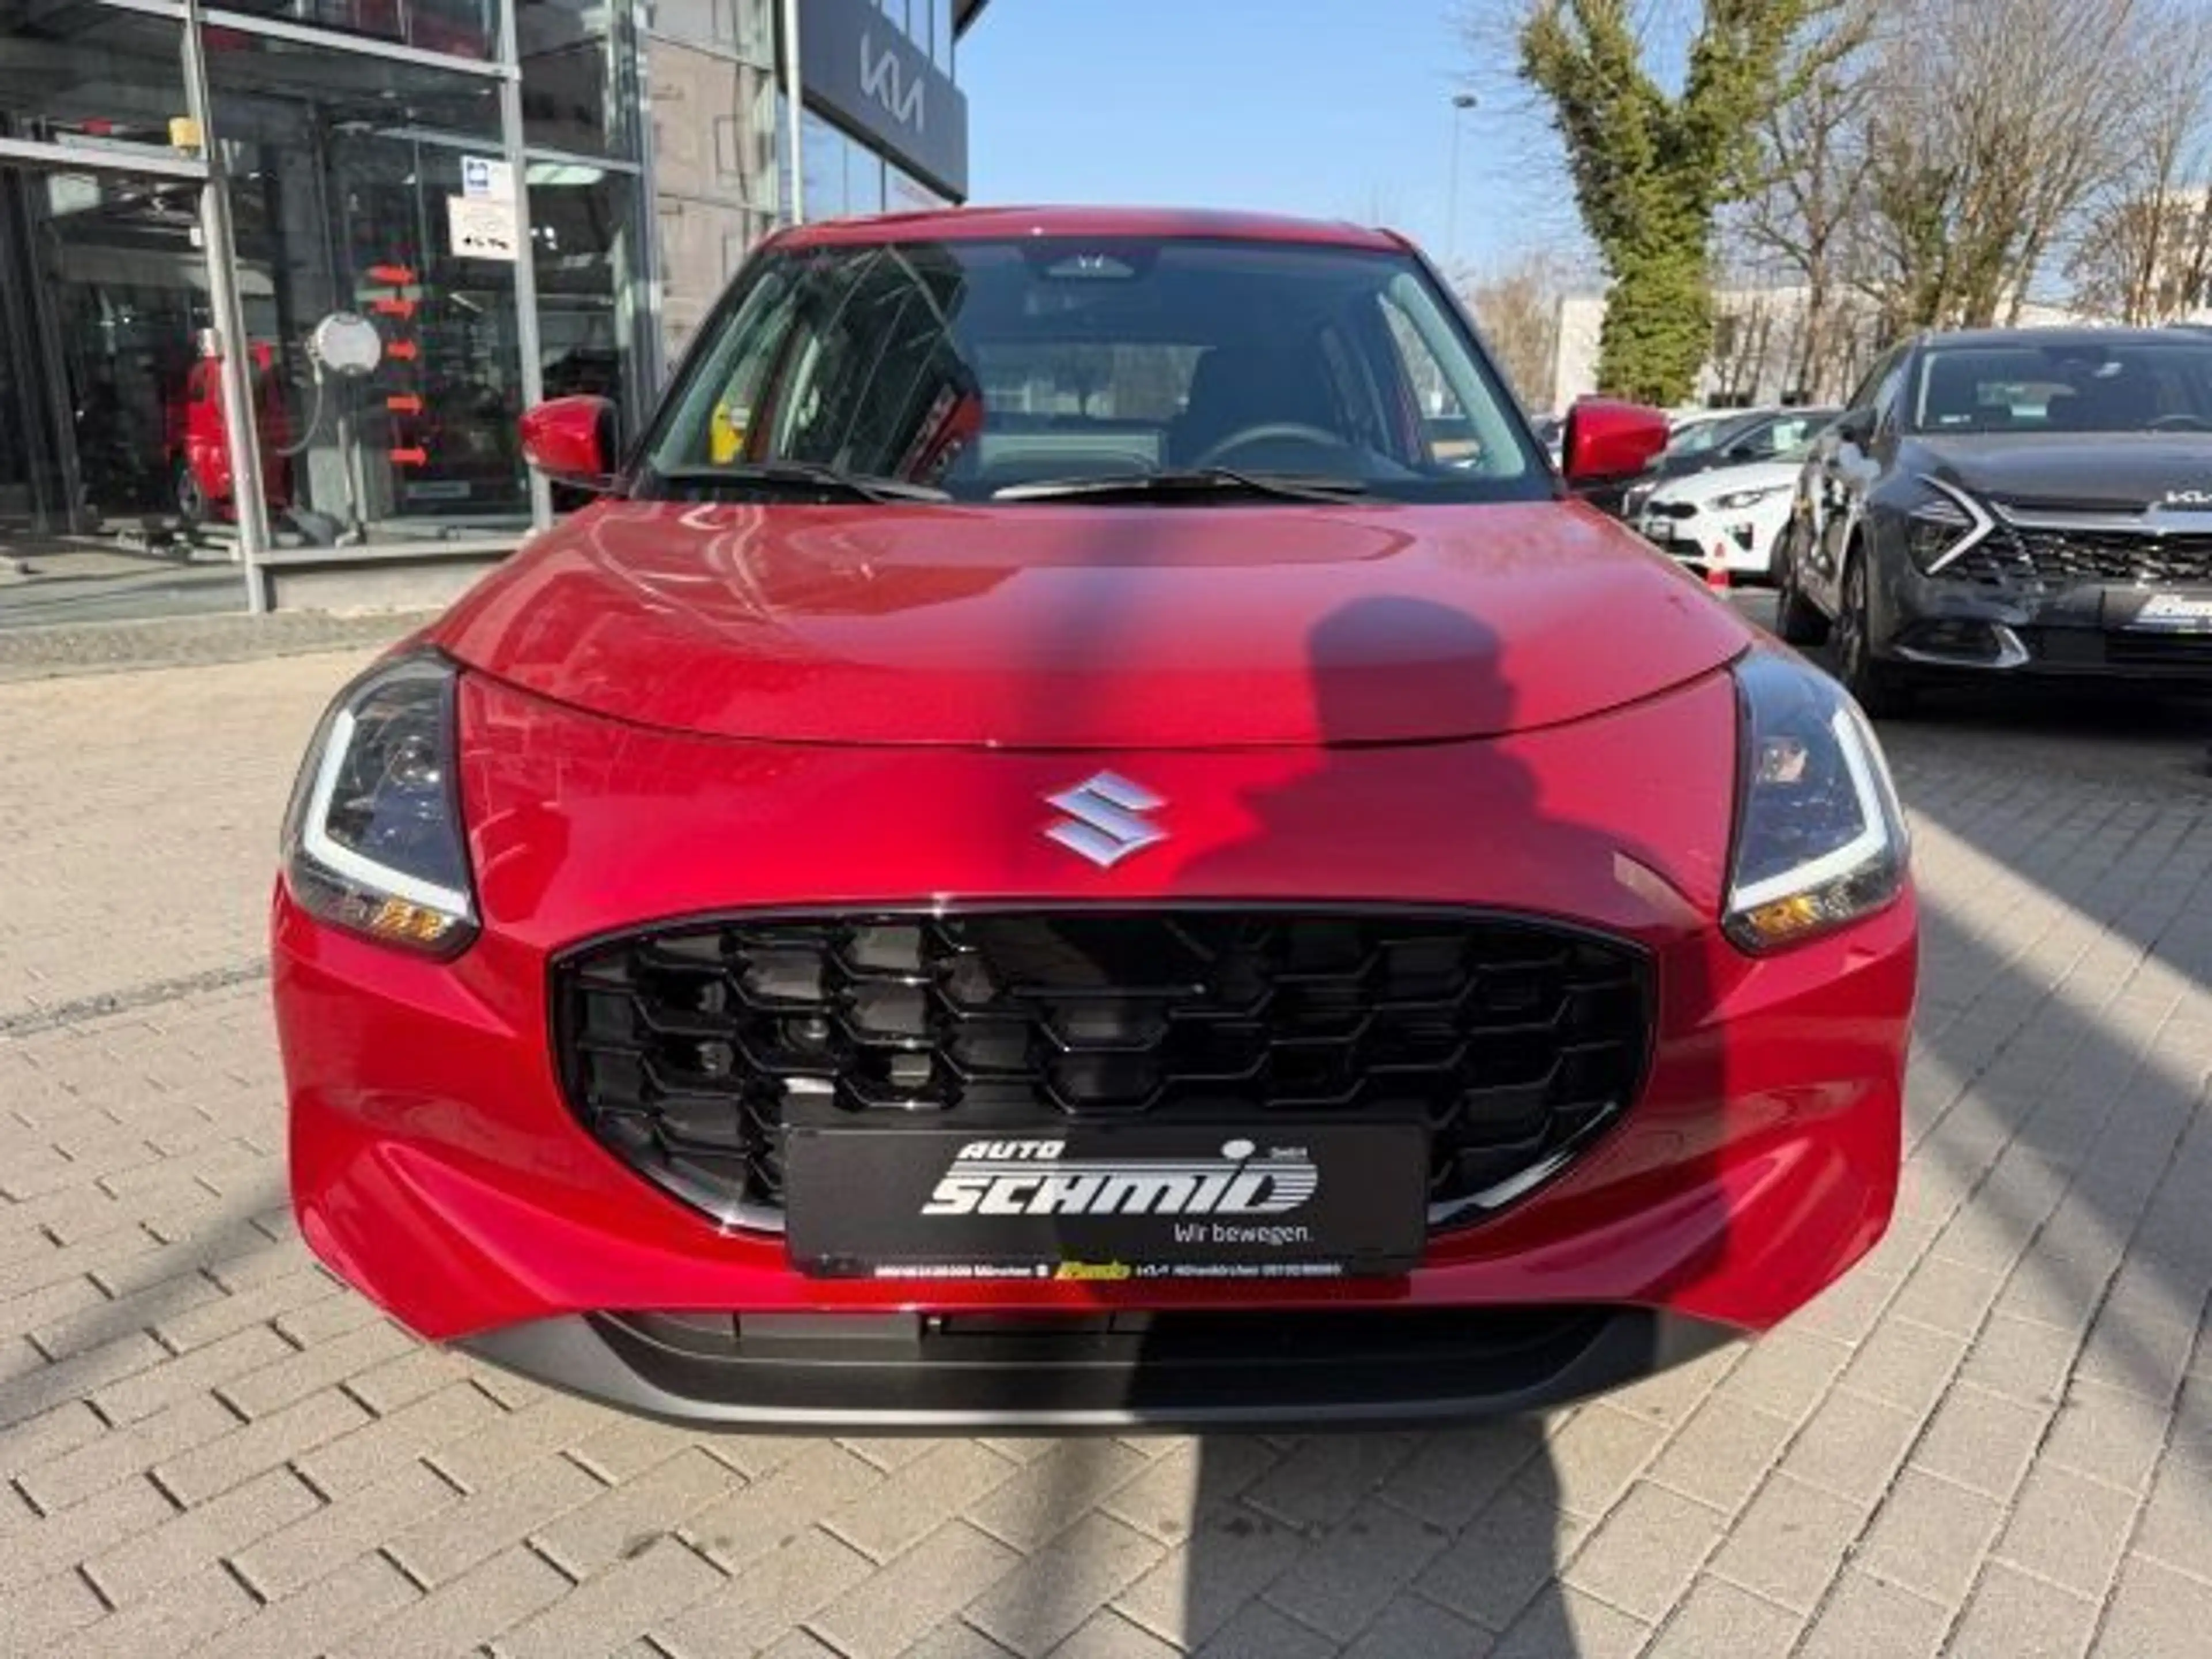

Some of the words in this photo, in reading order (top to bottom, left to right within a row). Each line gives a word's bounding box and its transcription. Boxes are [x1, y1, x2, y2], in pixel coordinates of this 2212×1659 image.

[861, 33, 924, 134] KIA
[2166, 490, 2212, 502] KI
[957, 1140, 1066, 1159] AUTO
[1173, 1222, 1209, 1243] Wir
